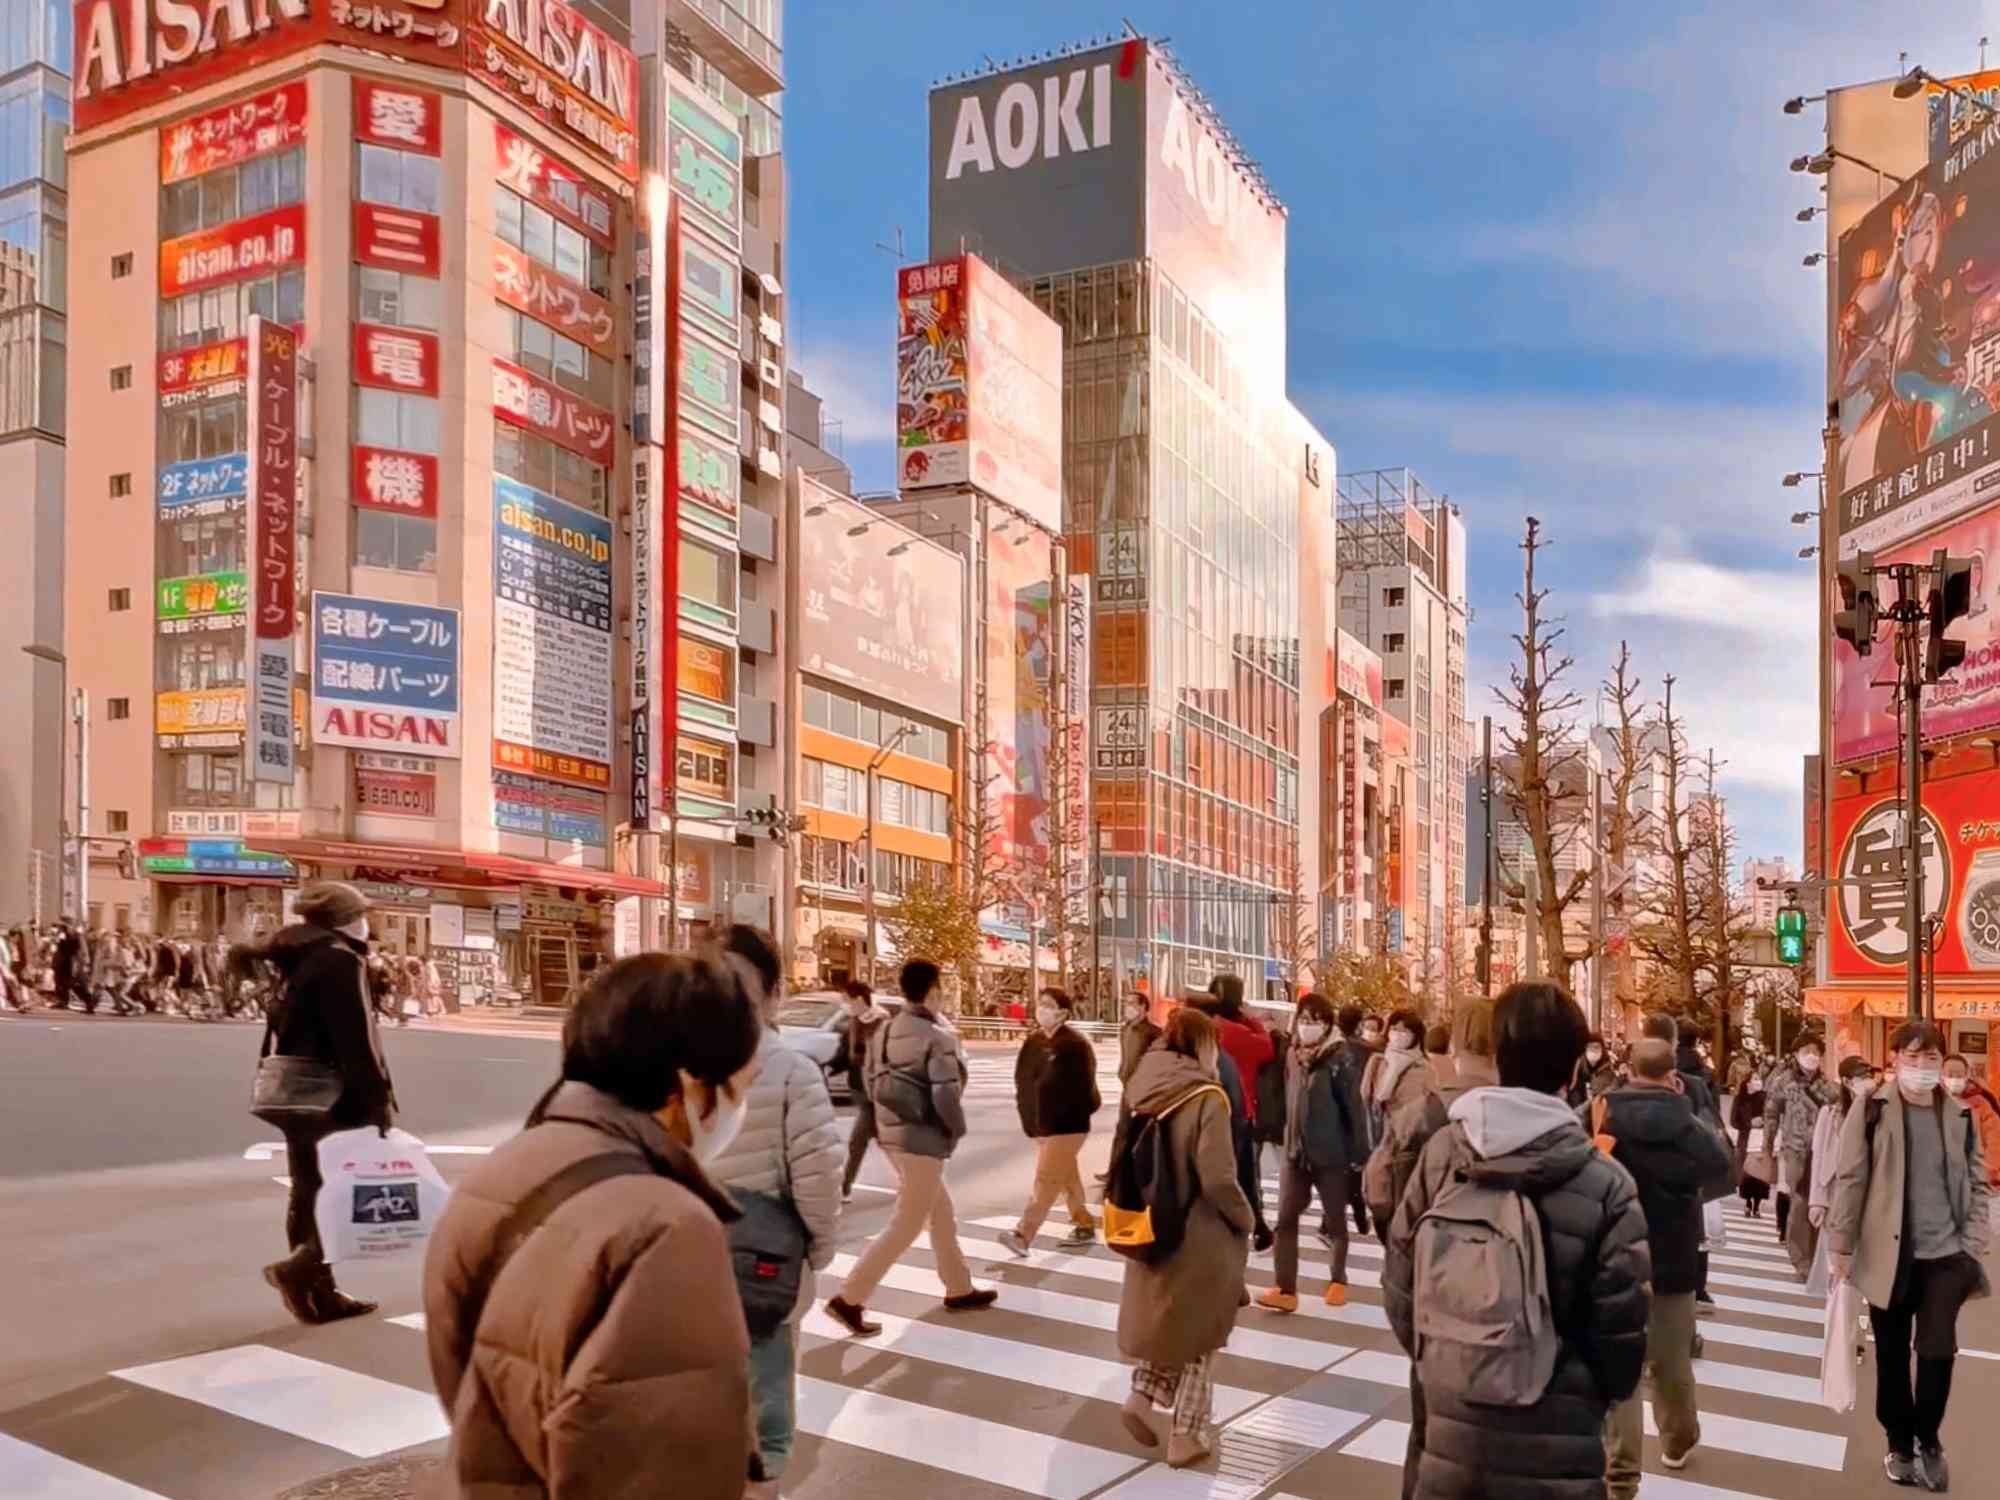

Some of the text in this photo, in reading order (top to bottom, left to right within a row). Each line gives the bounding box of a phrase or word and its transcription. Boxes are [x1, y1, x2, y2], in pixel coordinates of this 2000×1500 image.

[946, 64, 1111, 180] AOKI
[177, 224, 295, 285] aisan.co.jp
[501, 503, 610, 562] aisan.co.jp
[320, 606, 451, 647] 各種ケーブル
[1069, 583, 1087, 649] AKKY
[321, 658, 450, 697] 配線パーツ
[322, 707, 450, 747] AISAN
[634, 713, 649, 820] AISAN
